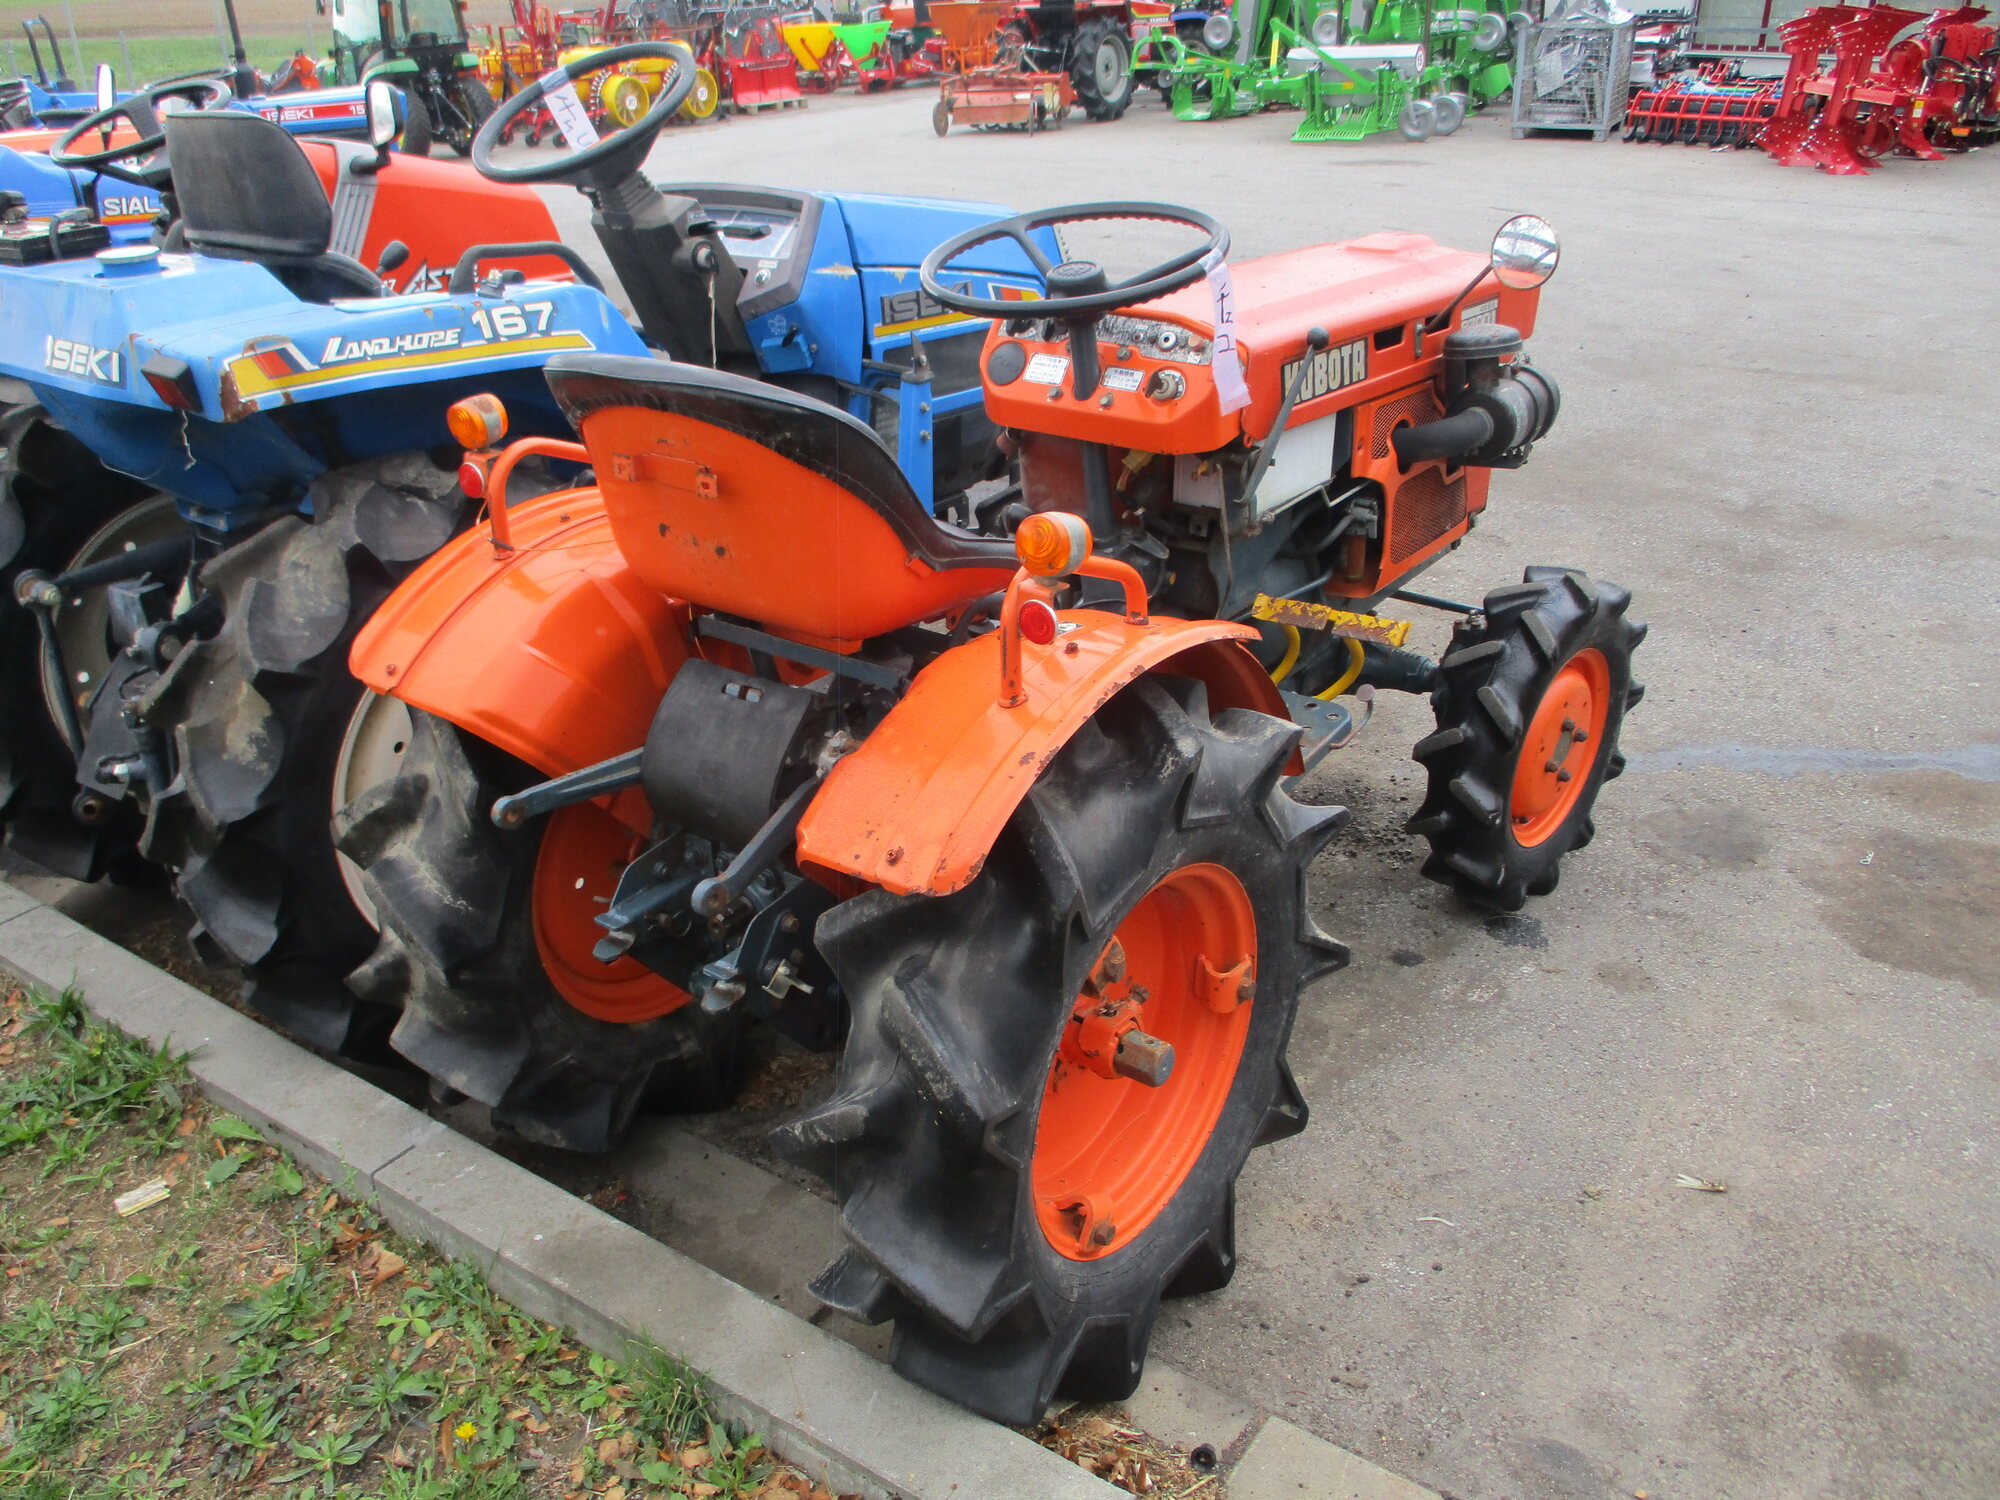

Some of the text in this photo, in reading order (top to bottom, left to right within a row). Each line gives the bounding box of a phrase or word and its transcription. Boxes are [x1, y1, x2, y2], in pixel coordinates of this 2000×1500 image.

[265, 108, 315, 122] ISEKI
[470, 300, 554, 340] 167
[44, 334, 122, 384] ISEKI
[1283, 339, 1368, 404] KUBOTA
